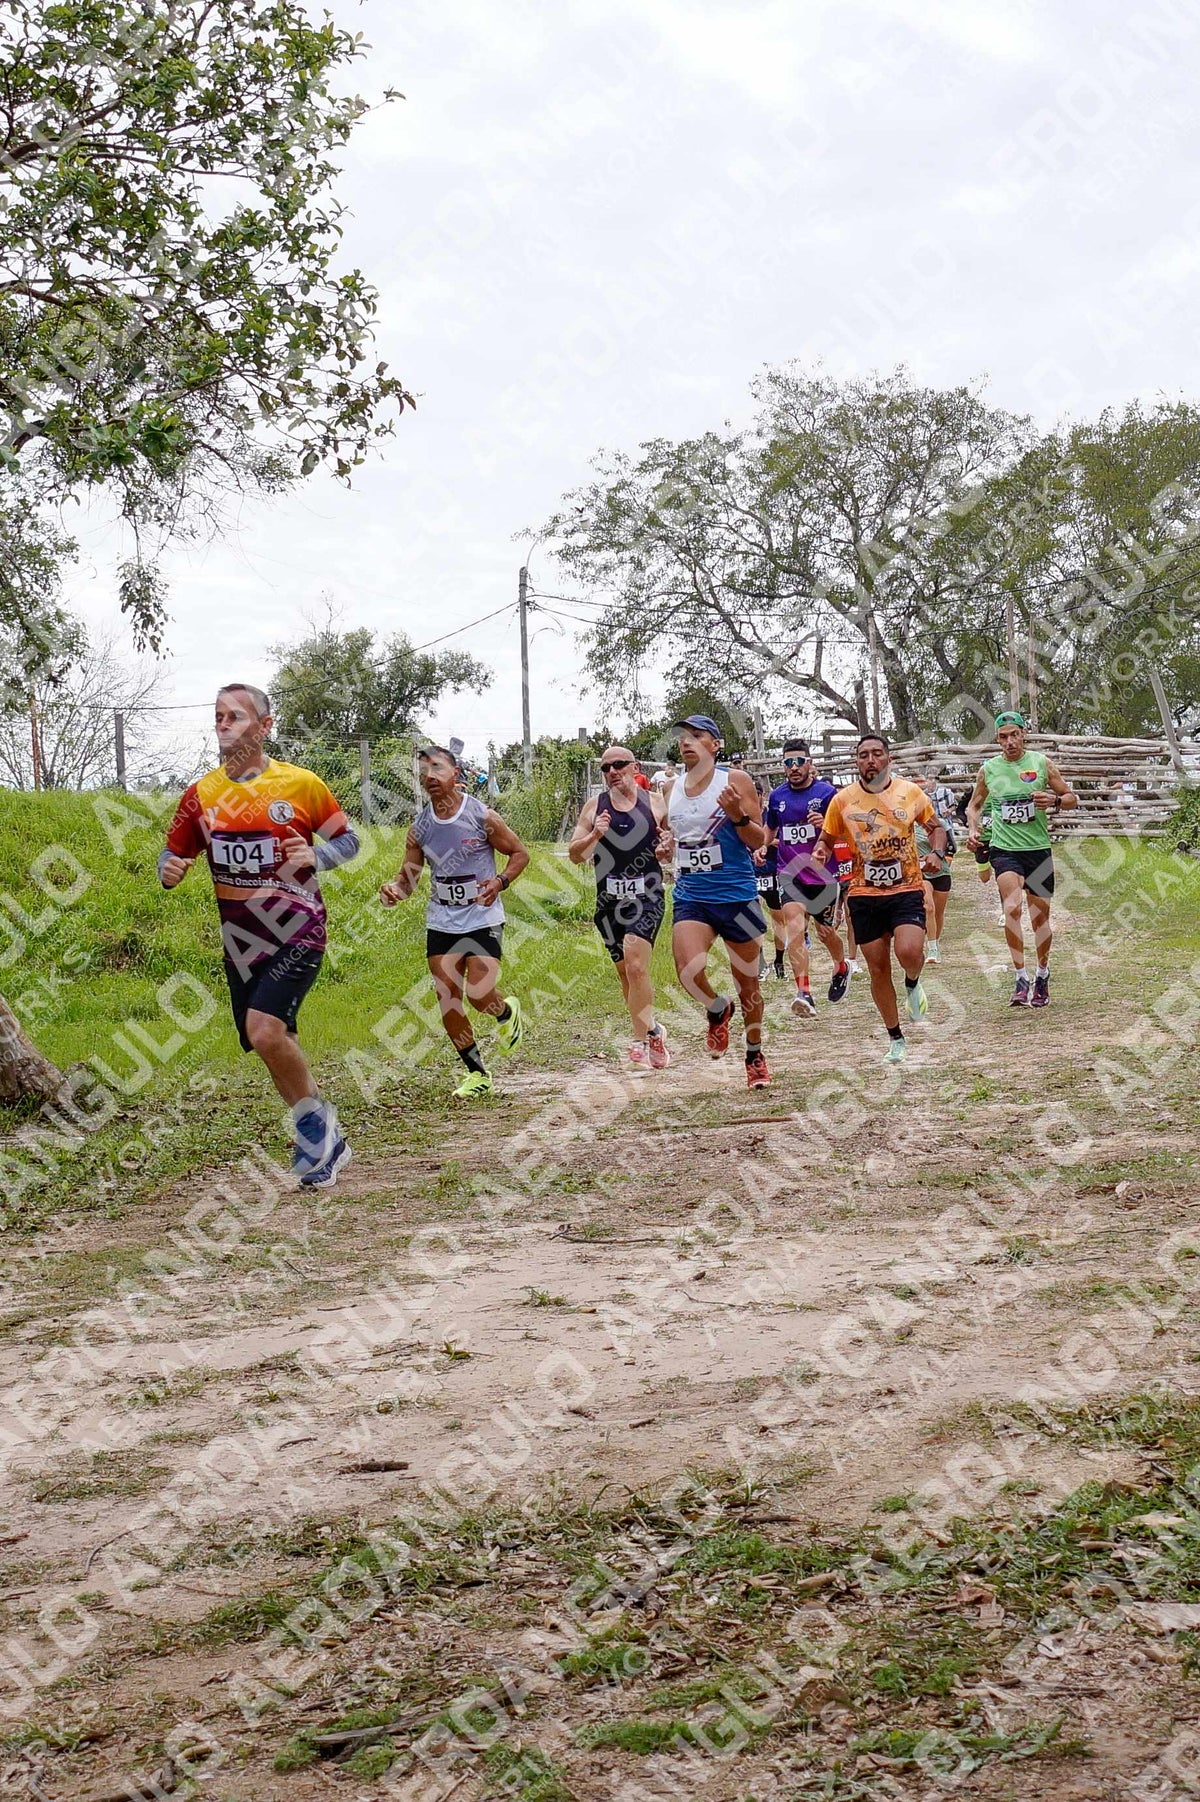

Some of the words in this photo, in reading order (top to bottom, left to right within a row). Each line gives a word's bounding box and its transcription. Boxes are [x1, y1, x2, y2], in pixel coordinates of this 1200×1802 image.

[1007, 805, 1031, 819] 251
[790, 827, 807, 840] 90
[221, 844, 265, 865] 104
[689, 850, 711, 867] 56
[869, 867, 898, 881] 220
[447, 885, 465, 900] 19
[614, 881, 637, 894] 114
